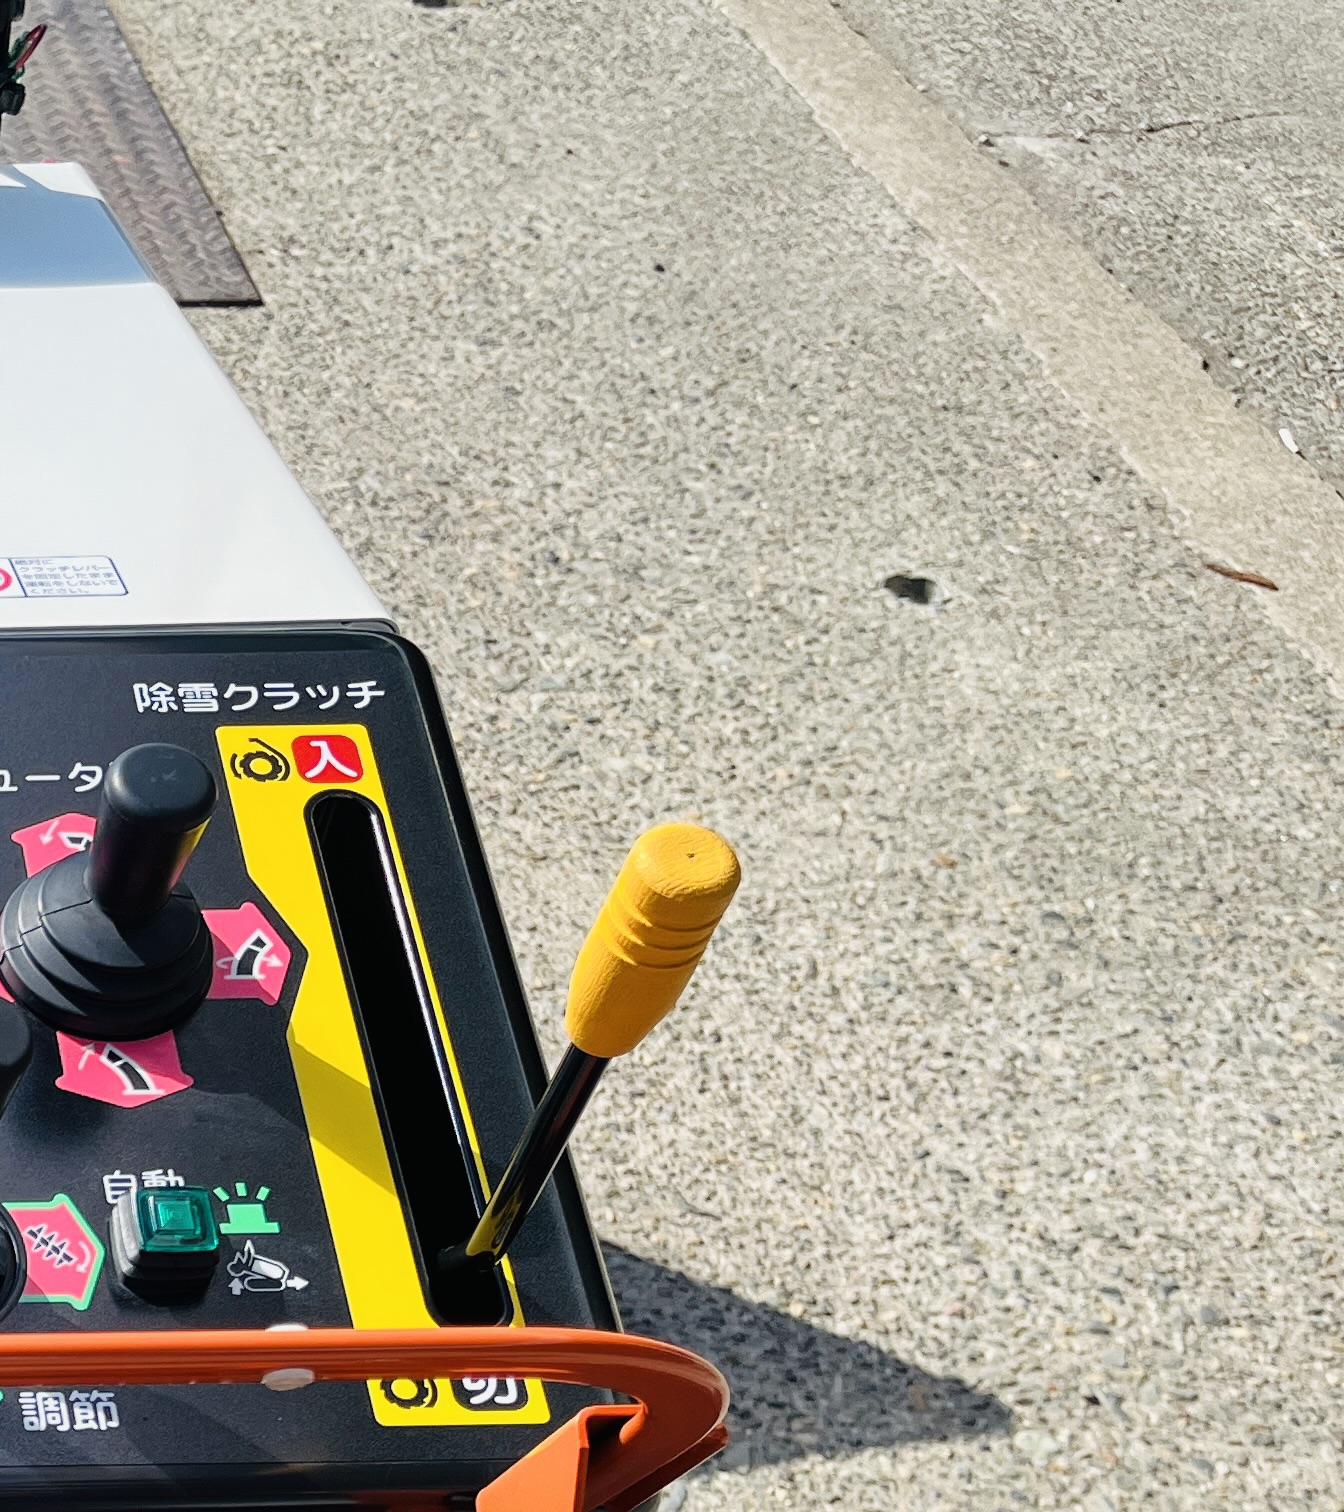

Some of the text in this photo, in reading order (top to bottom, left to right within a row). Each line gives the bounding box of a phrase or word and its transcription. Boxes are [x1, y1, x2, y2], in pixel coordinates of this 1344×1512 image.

[133, 680, 385, 713] 除雪クラッチ
[307, 740, 358, 779] 入
[19, 1389, 120, 1432] 調節
